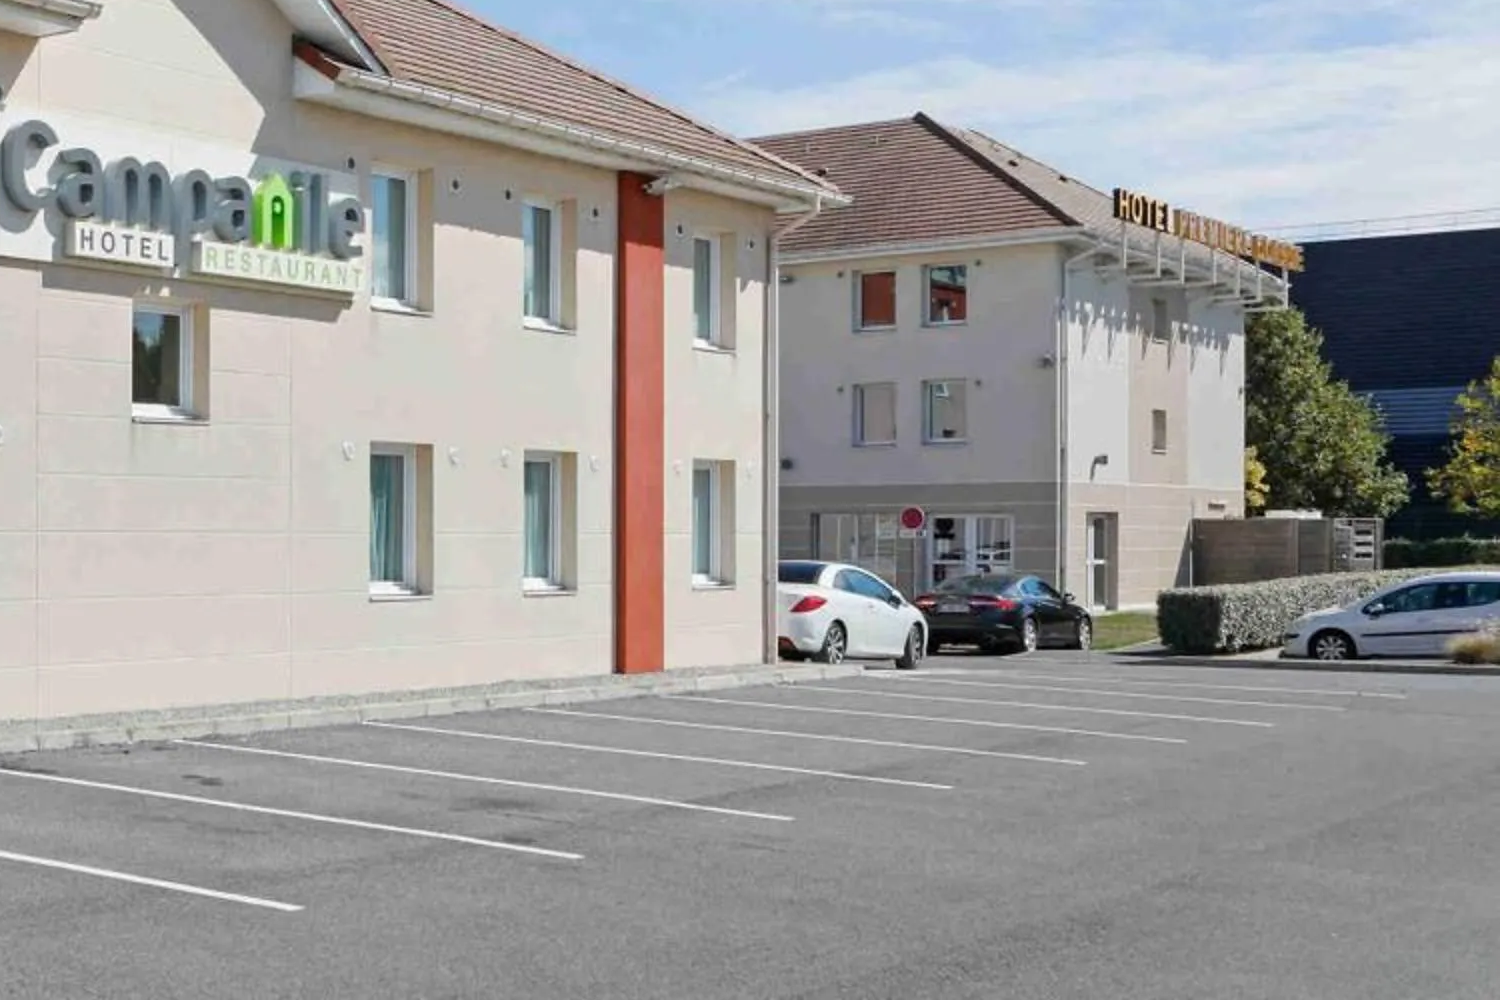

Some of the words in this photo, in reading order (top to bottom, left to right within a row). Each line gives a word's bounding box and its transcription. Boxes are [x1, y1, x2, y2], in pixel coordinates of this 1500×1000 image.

[2, 119, 364, 275] Campanile
[1113, 187, 1175, 235] HOTEL
[79, 228, 169, 262] HOTEL
[205, 247, 363, 287] RESTAURANT
